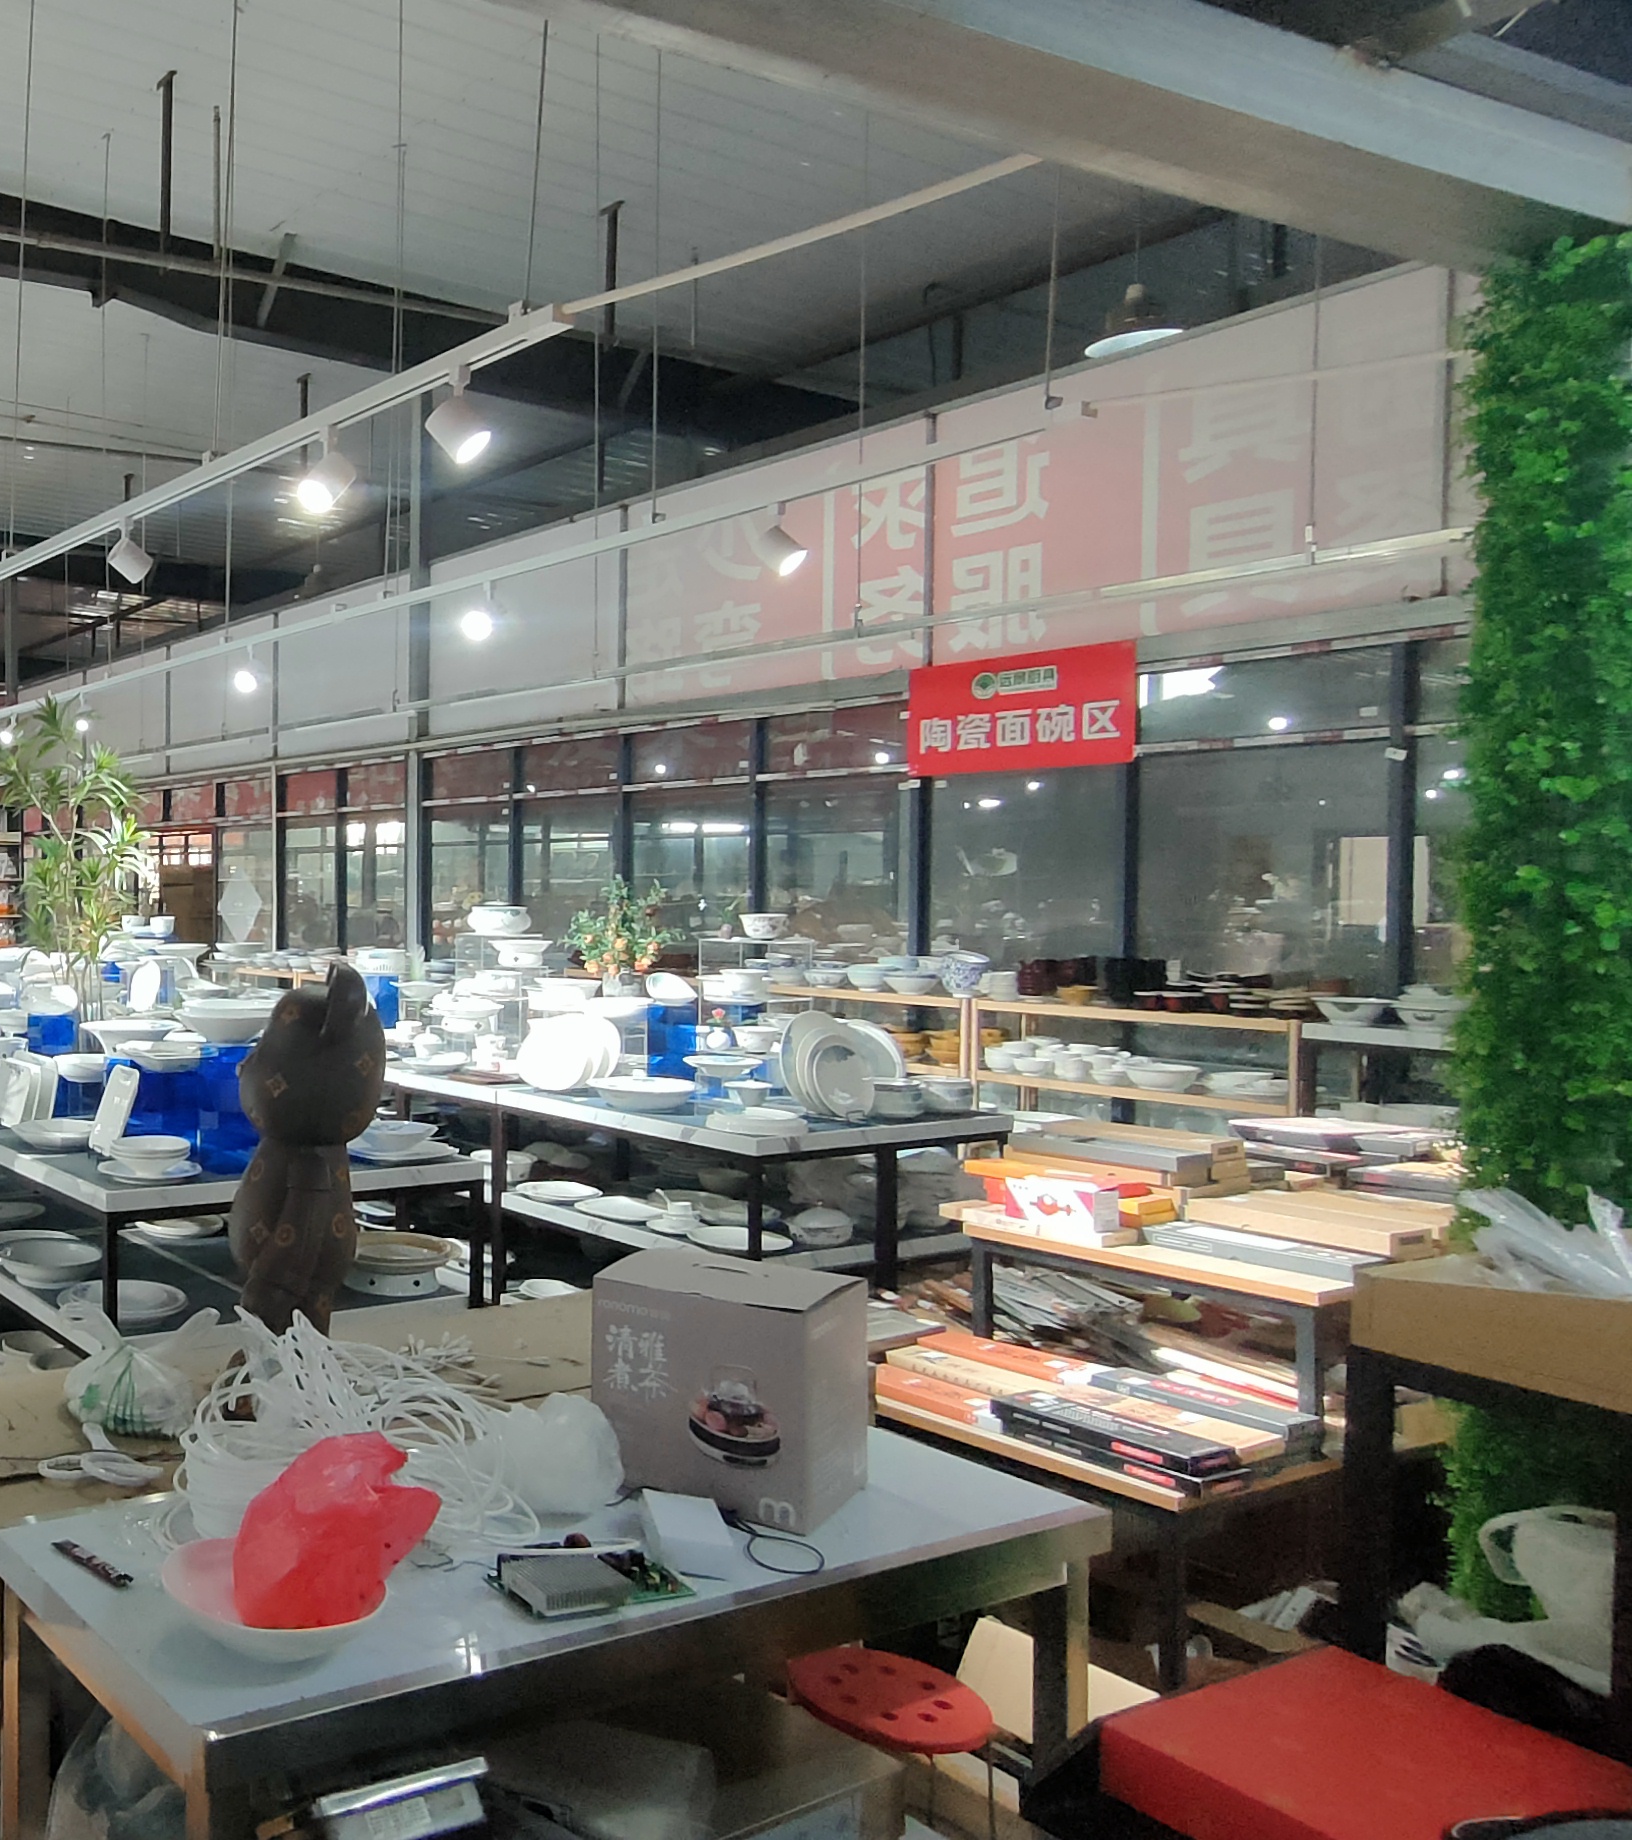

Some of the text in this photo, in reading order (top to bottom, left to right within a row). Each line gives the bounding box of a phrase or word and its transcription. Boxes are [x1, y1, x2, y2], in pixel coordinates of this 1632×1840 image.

[919, 699, 1121, 755] 陶瓷面碗区
